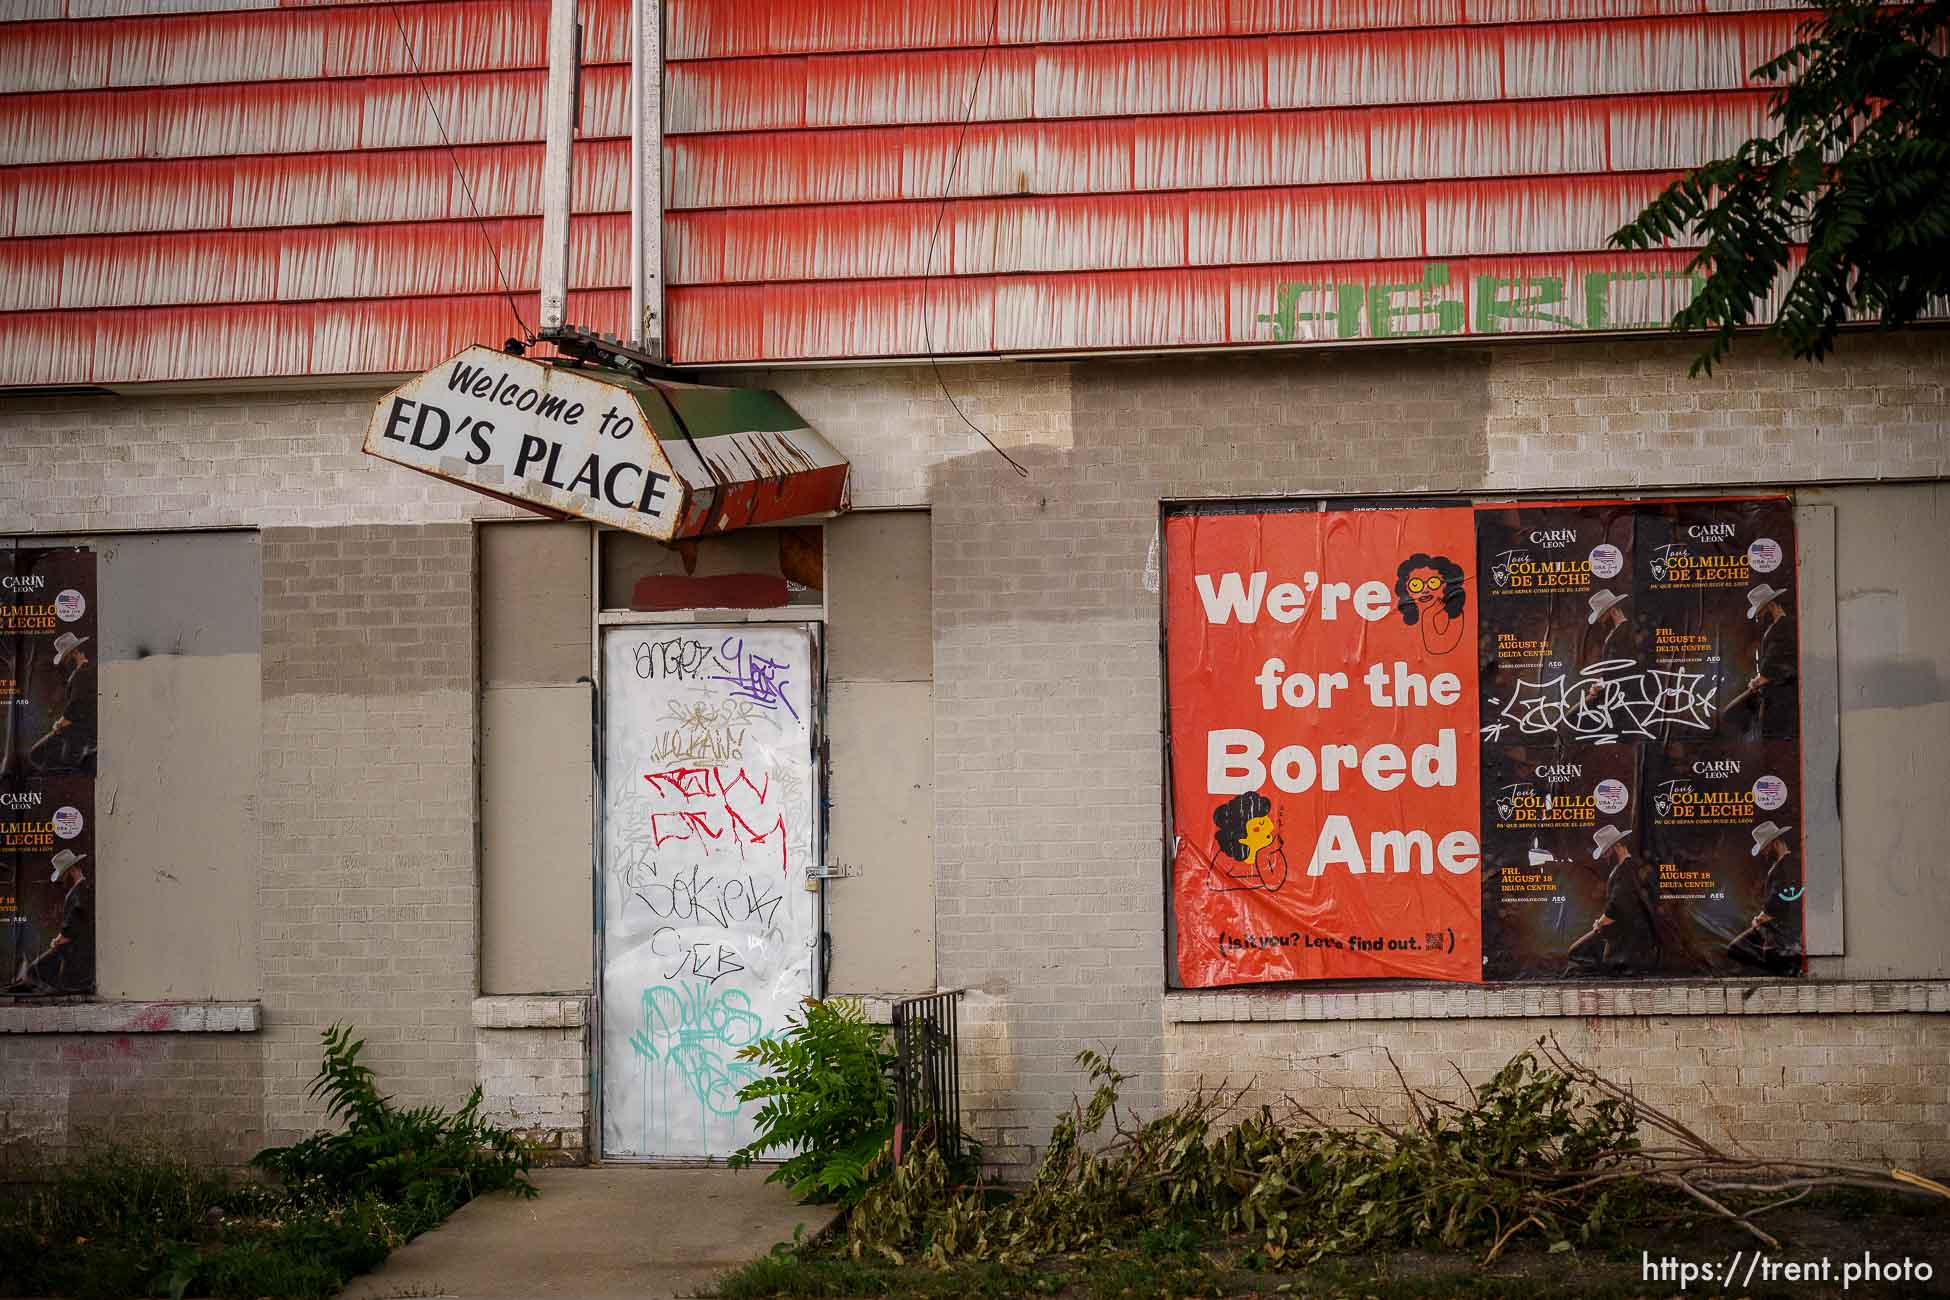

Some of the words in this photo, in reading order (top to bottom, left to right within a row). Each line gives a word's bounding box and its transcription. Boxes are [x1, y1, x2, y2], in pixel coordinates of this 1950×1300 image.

[448, 361, 585, 426] Welcome
[599, 406, 633, 440] to
[383, 396, 495, 465] ED'S
[514, 434, 671, 518] PLACE
[1509, 561, 1592, 575] COLMILLO
[1668, 554, 1750, 569] COLMILLO
[1511, 575, 1532, 587] DE
[1538, 573, 1591, 586] LECHE
[1669, 570, 1690, 581] DE
[1696, 568, 1749, 580] LECHE
[1195, 570, 1390, 625] We're
[8, 616, 56, 628] LECHE
[1499, 641, 1537, 649] AUGUST
[1656, 635, 1695, 644] AUGUST
[1255, 657, 1348, 710] for
[1364, 661, 1461, 707] the
[1206, 728, 1457, 795] Bored
[1514, 795, 1596, 808] COLMILLO
[1672, 791, 1755, 805] COLMILLO
[1515, 810, 1537, 821] DE
[1543, 808, 1595, 820] LECHE
[1673, 805, 1694, 817] DE
[1700, 804, 1754, 817] LECHE
[6, 834, 54, 845] LECHE
[1307, 815, 1479, 876] Ame
[1502, 875, 1541, 883] AUGUST
[1660, 872, 1698, 880] AUGUST
[1348, 936, 1383, 951] find
[1388, 936, 1422, 950] out.
